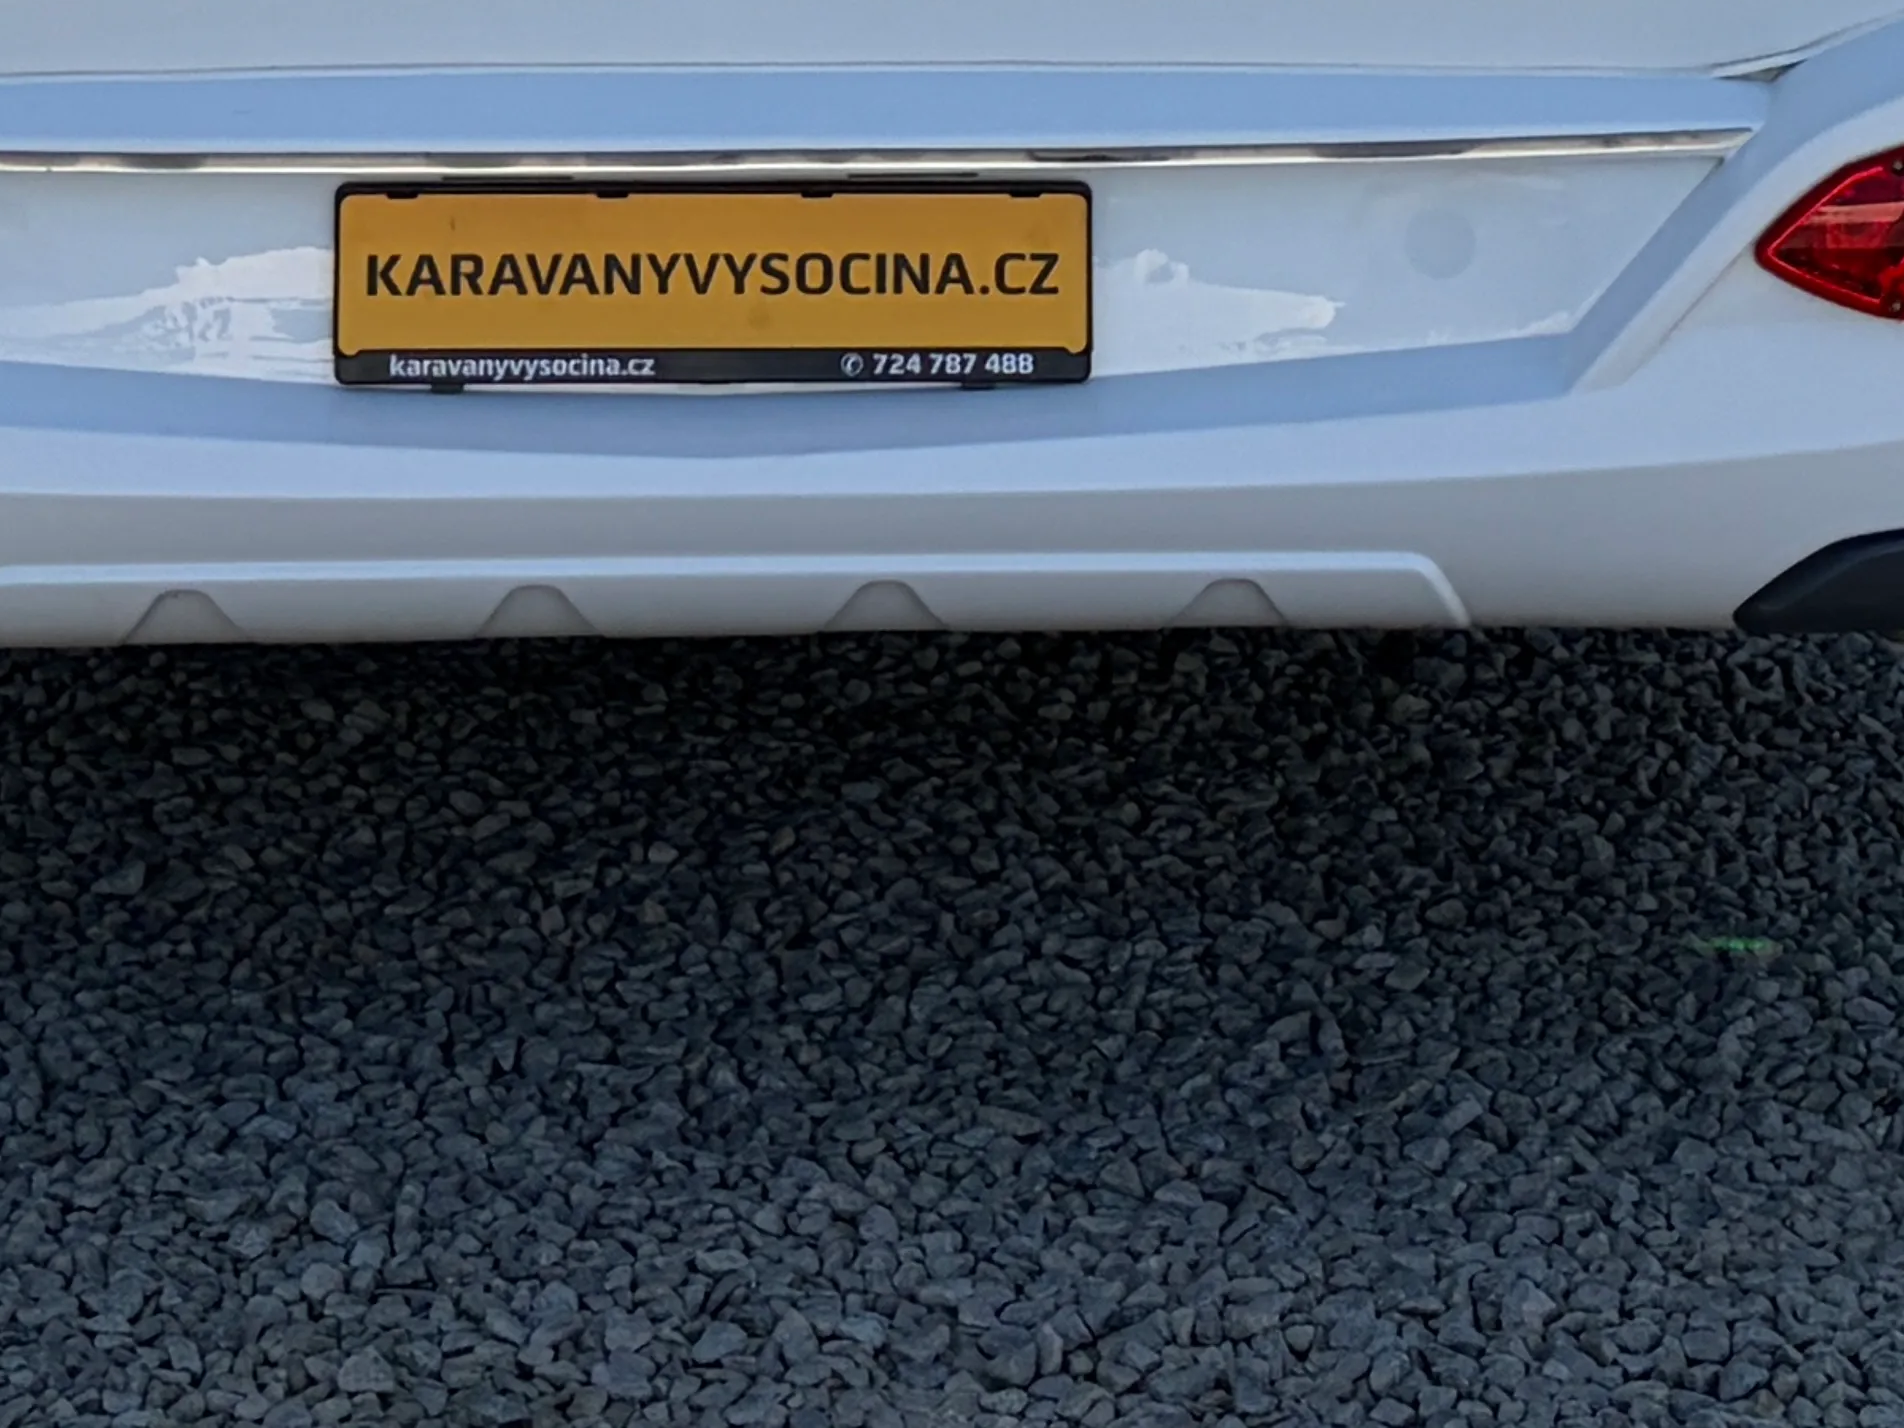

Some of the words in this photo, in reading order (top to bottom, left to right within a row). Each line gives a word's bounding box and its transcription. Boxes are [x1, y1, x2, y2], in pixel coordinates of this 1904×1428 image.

[366, 252, 1059, 296] KARAVANYVYSOCINA.CZ
[389, 354, 656, 378] karavanyvysocina.cz
[873, 354, 922, 375] 724
[930, 354, 977, 375] 787
[985, 353, 1034, 375] 488
